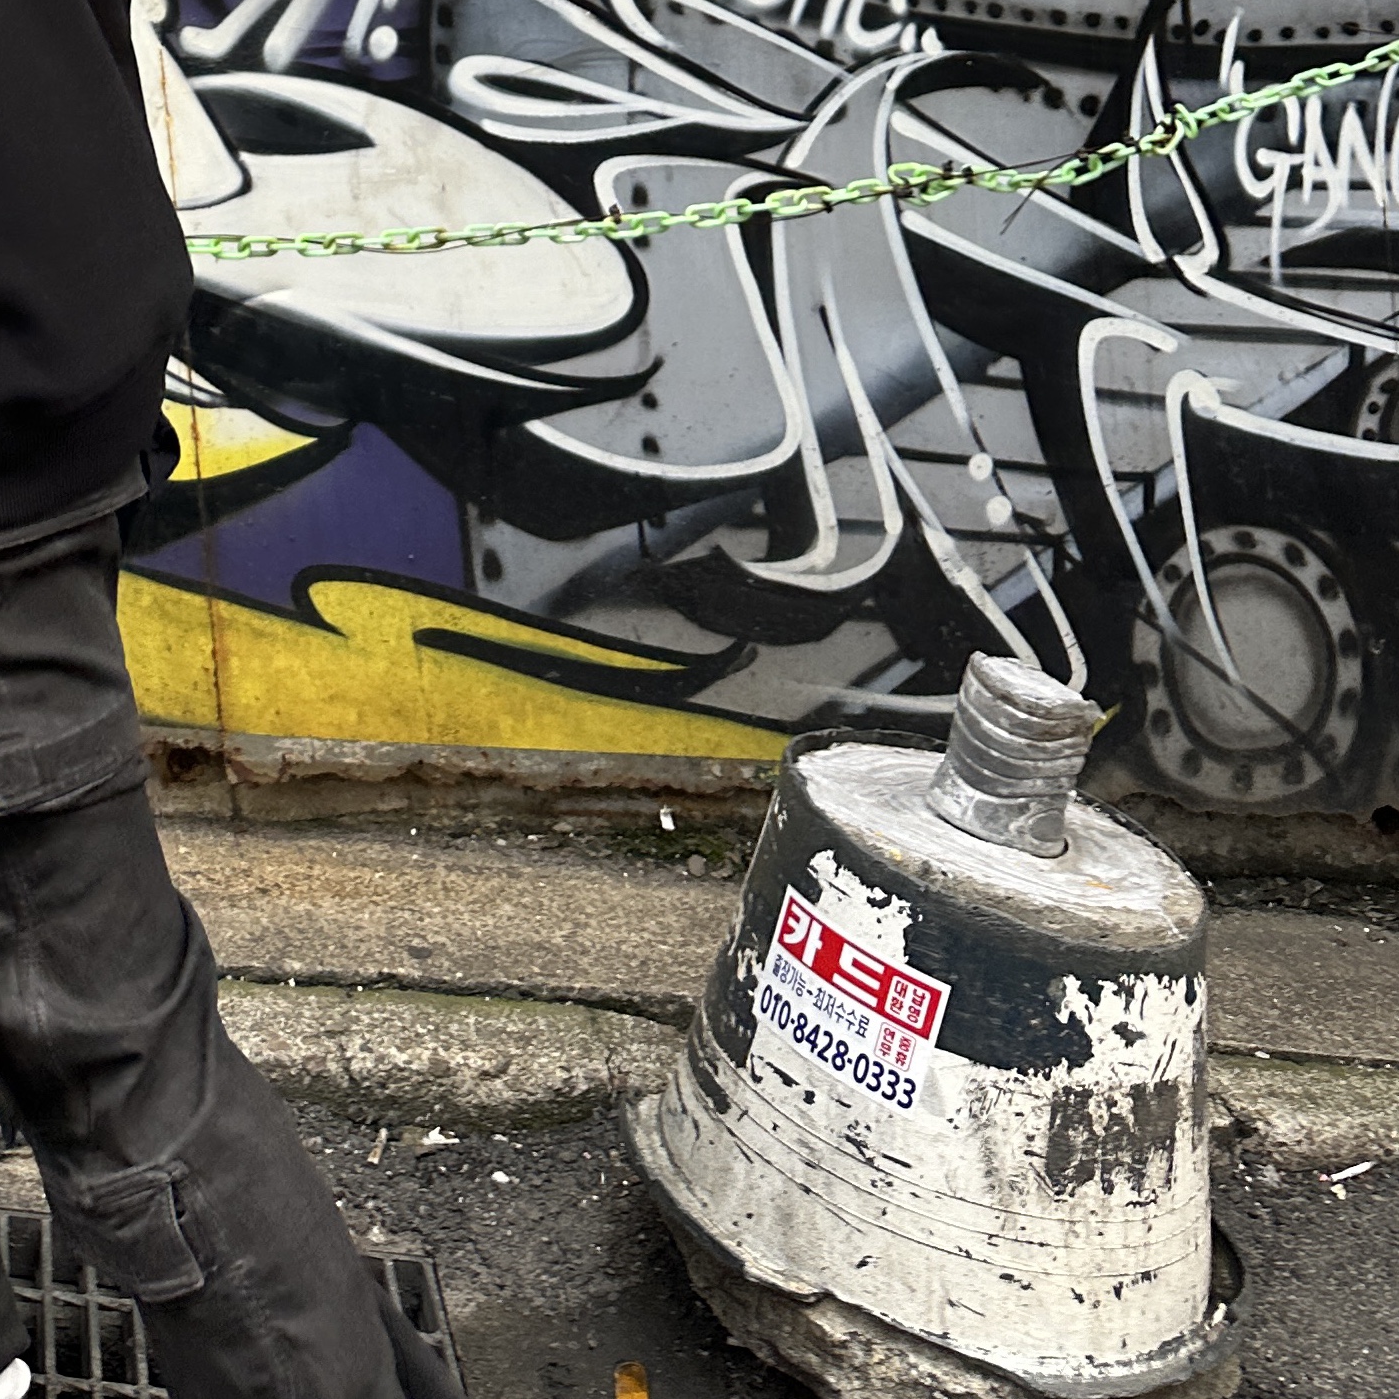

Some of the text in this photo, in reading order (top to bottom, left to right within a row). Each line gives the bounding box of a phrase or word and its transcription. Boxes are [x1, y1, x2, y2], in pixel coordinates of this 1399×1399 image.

[1235, 64, 1399, 286] GAN
[783, 904, 885, 1008] 카드
[760, 984, 917, 1109] 010-8428-0333
